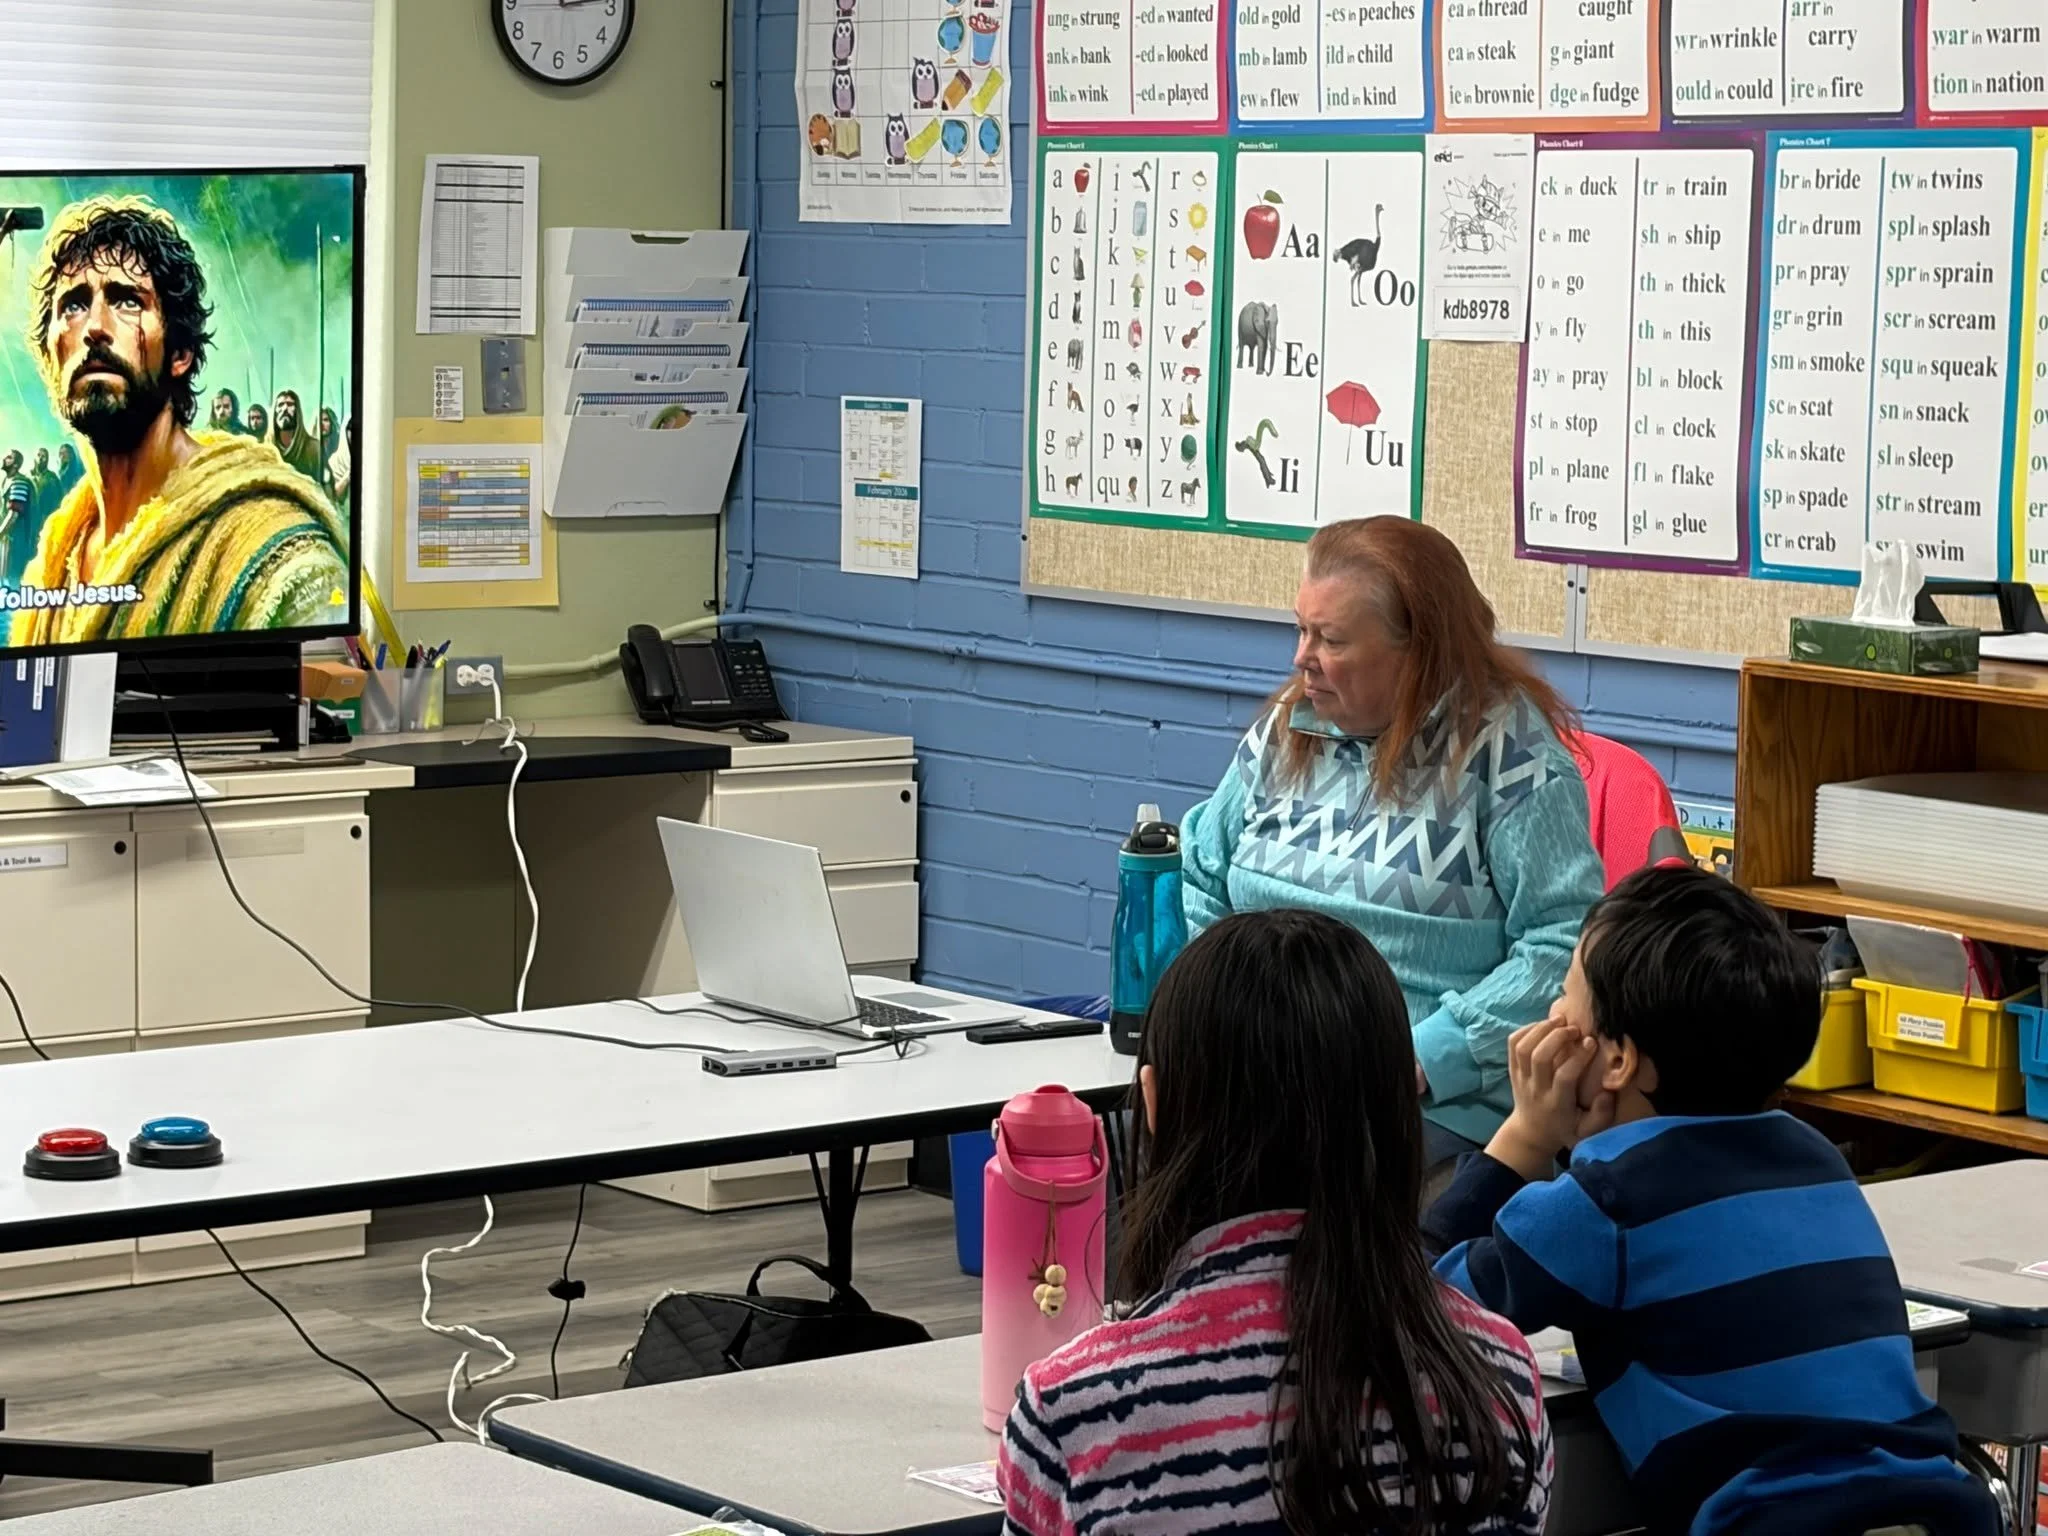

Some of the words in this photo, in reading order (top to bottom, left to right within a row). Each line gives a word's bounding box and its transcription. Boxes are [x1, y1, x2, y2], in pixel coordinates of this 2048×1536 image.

[605, 0, 616, 16] 3
[1136, 5, 1155, 24] -ed
[1158, 14, 1165, 23] in
[1166, 4, 1213, 22] wanted
[1239, 6, 1259, 25] old
[1262, 14, 1269, 24] in
[1272, 4, 1300, 30] gold
[1326, 8, 1345, 26] -es
[1348, 10, 1356, 21] in
[1359, 1, 1415, 27] peaches
[1448, 3, 1464, 18] ea
[1467, 6, 1475, 16] in
[1479, 0, 1527, 16] thread
[1579, 0, 1633, 21] caught
[1791, 0, 1821, 16] arr
[1823, 2, 1833, 16] in
[512, 21, 524, 40] 8
[1048, 14, 1069, 31] ung
[1071, 16, 1078, 26] in
[1080, 11, 1120, 30] strung
[596, 25, 607, 45] 4
[1675, 35, 1698, 49] wr
[1699, 36, 1708, 48] in
[1710, 26, 1777, 48] wrinkle
[1808, 29, 1857, 51] carry
[1932, 29, 1970, 46] war
[1972, 31, 1982, 44] in
[1986, 27, 2040, 44] warm
[531, 42, 542, 61] 7
[553, 51, 564, 69] 6
[577, 45, 588, 63] 5
[1047, 47, 1069, 64] ank
[1071, 55, 1078, 63] in
[1080, 46, 1111, 64] bank
[1136, 45, 1155, 62] -ed
[1158, 53, 1164, 62] in
[1167, 43, 1208, 62] looked
[1326, 45, 1344, 64] ild
[1347, 53, 1355, 63] in
[1358, 43, 1392, 63] child
[1551, 46, 1559, 66] g
[1562, 50, 1570, 59] in
[1574, 39, 1614, 65] giant
[1676, 80, 1711, 100] ould
[1715, 88, 1724, 100] in
[1727, 78, 1773, 100] could
[1933, 73, 1968, 94] tion
[1972, 80, 1982, 93] in
[1986, 70, 2044, 93] nation
[1240, 94, 1256, 107] ew
[1260, 96, 1268, 107] in
[1270, 88, 1299, 107] flew
[1550, 83, 1577, 108] dge
[1580, 91, 1589, 101] in
[1593, 81, 1639, 108] fudge
[1562, 140, 1578, 148] Chart
[1806, 137, 1825, 146] Chart
[1053, 169, 1062, 188] a
[1541, 176, 1557, 195] ck
[1565, 186, 1572, 195] in
[1580, 176, 1617, 195] duck
[1644, 178, 1658, 195] tr
[1666, 184, 1675, 195] in
[1684, 176, 1727, 196] train
[1780, 169, 1800, 189] br
[1802, 177, 1811, 189] in
[1815, 168, 1860, 190] bride
[1890, 171, 1914, 191] tw
[1917, 176, 1927, 189] in
[1932, 167, 1983, 189] twins
[1051, 206, 1061, 234] b
[1888, 214, 1915, 242] spl
[1918, 222, 1928, 236] in
[1932, 215, 1990, 242] splash
[1281, 224, 1320, 258] Aa
[1539, 228, 1546, 242] e
[1553, 234, 1560, 242] in
[1568, 229, 1590, 243] me
[1642, 224, 1658, 244] sh
[1668, 233, 1676, 244] in
[1685, 224, 1721, 250] ship
[1050, 256, 1060, 275] c
[1775, 265, 1795, 286] pr
[1798, 270, 1806, 280] in
[1810, 265, 1850, 287] pray
[1374, 270, 1415, 306] Oo
[1049, 293, 1059, 320] d
[1443, 298, 1510, 320] kdb8978
[1639, 320, 1654, 339] th
[1663, 329, 1671, 339] in
[1681, 321, 1711, 342] this
[1048, 341, 1057, 360] e
[1283, 342, 1318, 378] Ee
[1771, 355, 1794, 369] sm
[1798, 358, 1807, 370] in
[1810, 351, 1865, 372] smoke
[1533, 368, 1547, 388] ay
[1557, 373, 1564, 383] in
[1573, 370, 1608, 391] pray
[1881, 358, 1913, 380] squ
[1917, 362, 1927, 375] in
[1931, 356, 1998, 382] squeak
[1048, 380, 1058, 407] f
[1635, 415, 1648, 434] cl
[1656, 424, 1664, 435] in
[1673, 417, 1716, 438] clock
[1044, 429, 1055, 455] g
[1365, 430, 1403, 467] Uu
[1766, 439, 1784, 459] sk
[1788, 448, 1796, 460] in
[1800, 440, 1845, 463] skate
[1044, 465, 1056, 492] h
[1278, 458, 1299, 493] Ii
[1530, 456, 1543, 480] pl
[1551, 467, 1559, 476] in
[1567, 458, 1609, 483] plane
[1097, 476, 1120, 503] qu
[1530, 501, 1543, 521] fr
[1550, 511, 1557, 522] in
[1566, 504, 1597, 531] frog
[1916, 541, 1965, 562] swim
[0, 586, 67, 609] follow
[70, 583, 143, 605] Jesus.
